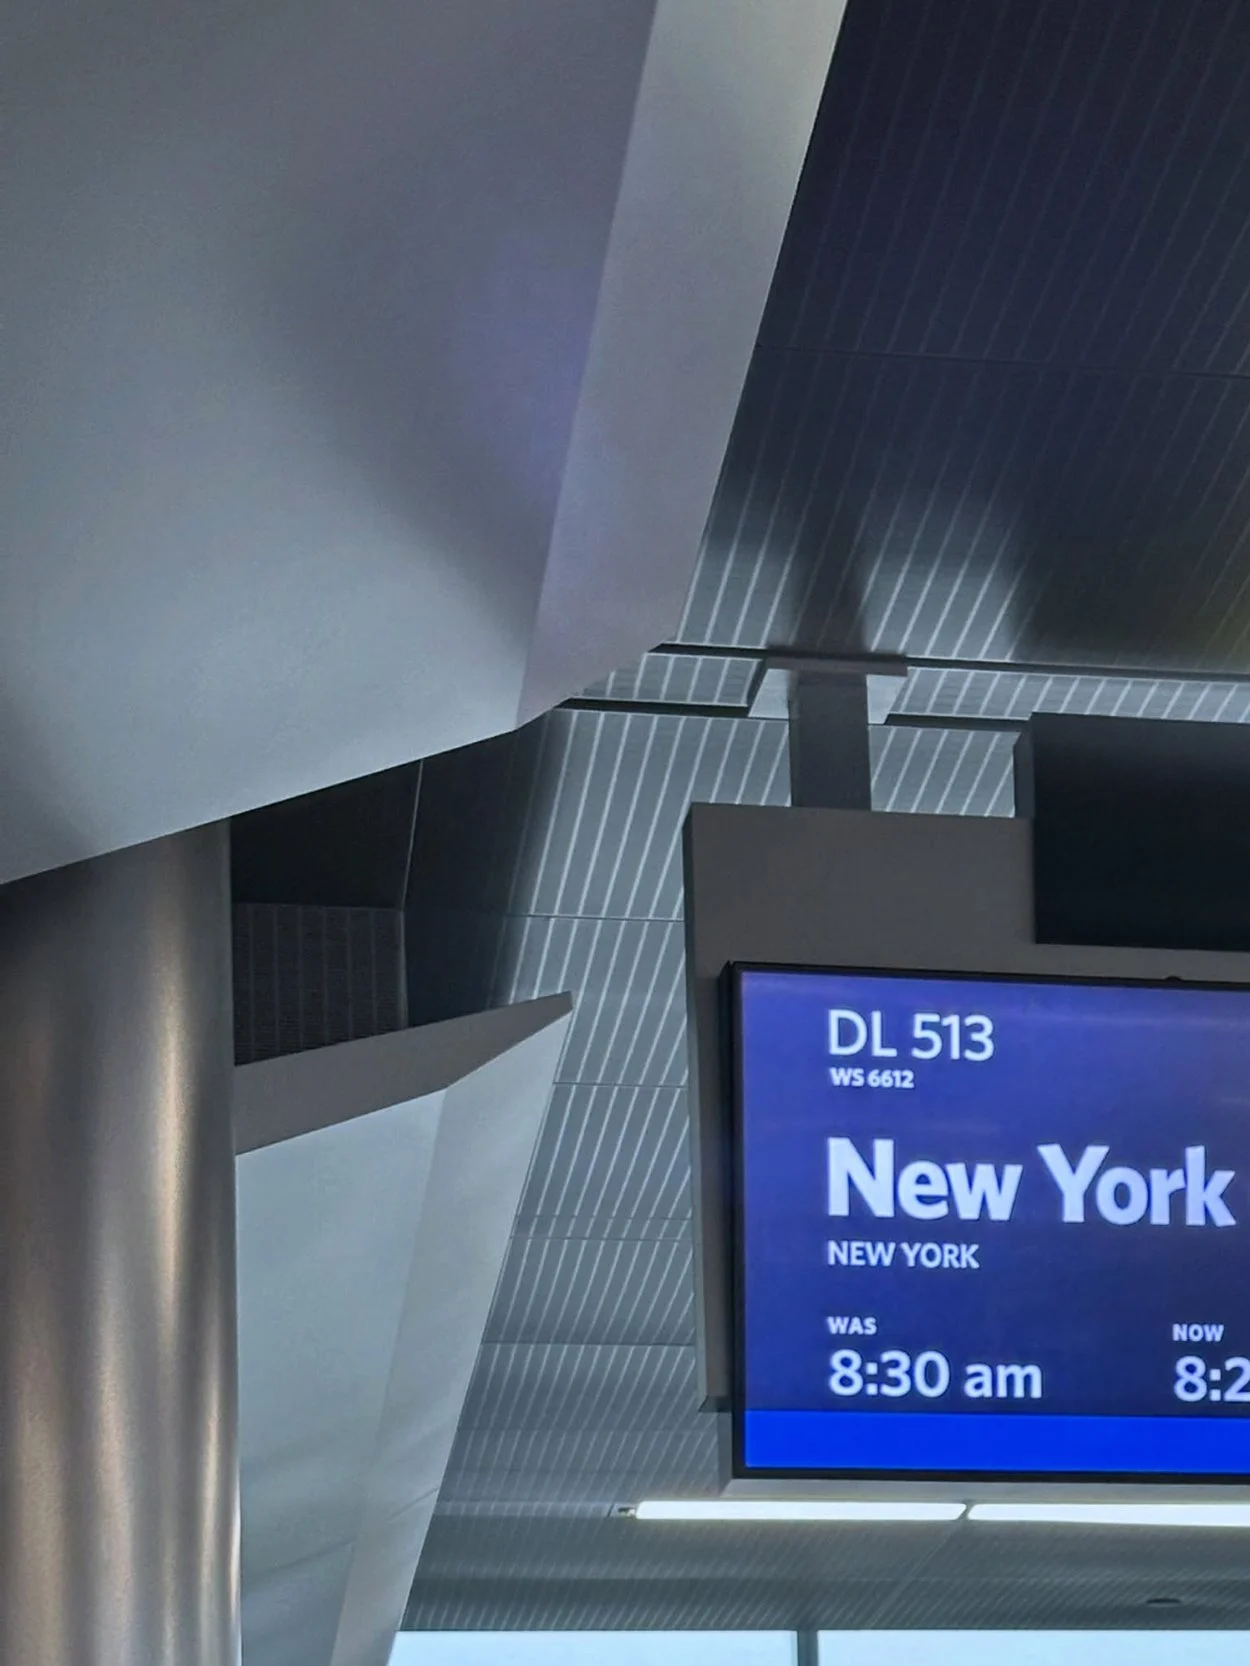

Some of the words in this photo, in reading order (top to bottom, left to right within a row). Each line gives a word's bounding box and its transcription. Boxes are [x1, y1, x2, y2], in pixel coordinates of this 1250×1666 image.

[828, 1009, 897, 1058] DL
[911, 1012, 994, 1062] 513
[829, 1067, 865, 1087] WS
[867, 1069, 915, 1089] 6612
[827, 1137, 1023, 1222] New
[1036, 1143, 1236, 1228] York
[827, 1240, 896, 1267] NEW
[902, 1242, 980, 1269] YORK
[826, 1316, 877, 1335] WAS
[1172, 1323, 1225, 1342] NOW
[828, 1349, 950, 1398] 8:30
[963, 1363, 1042, 1399] am
